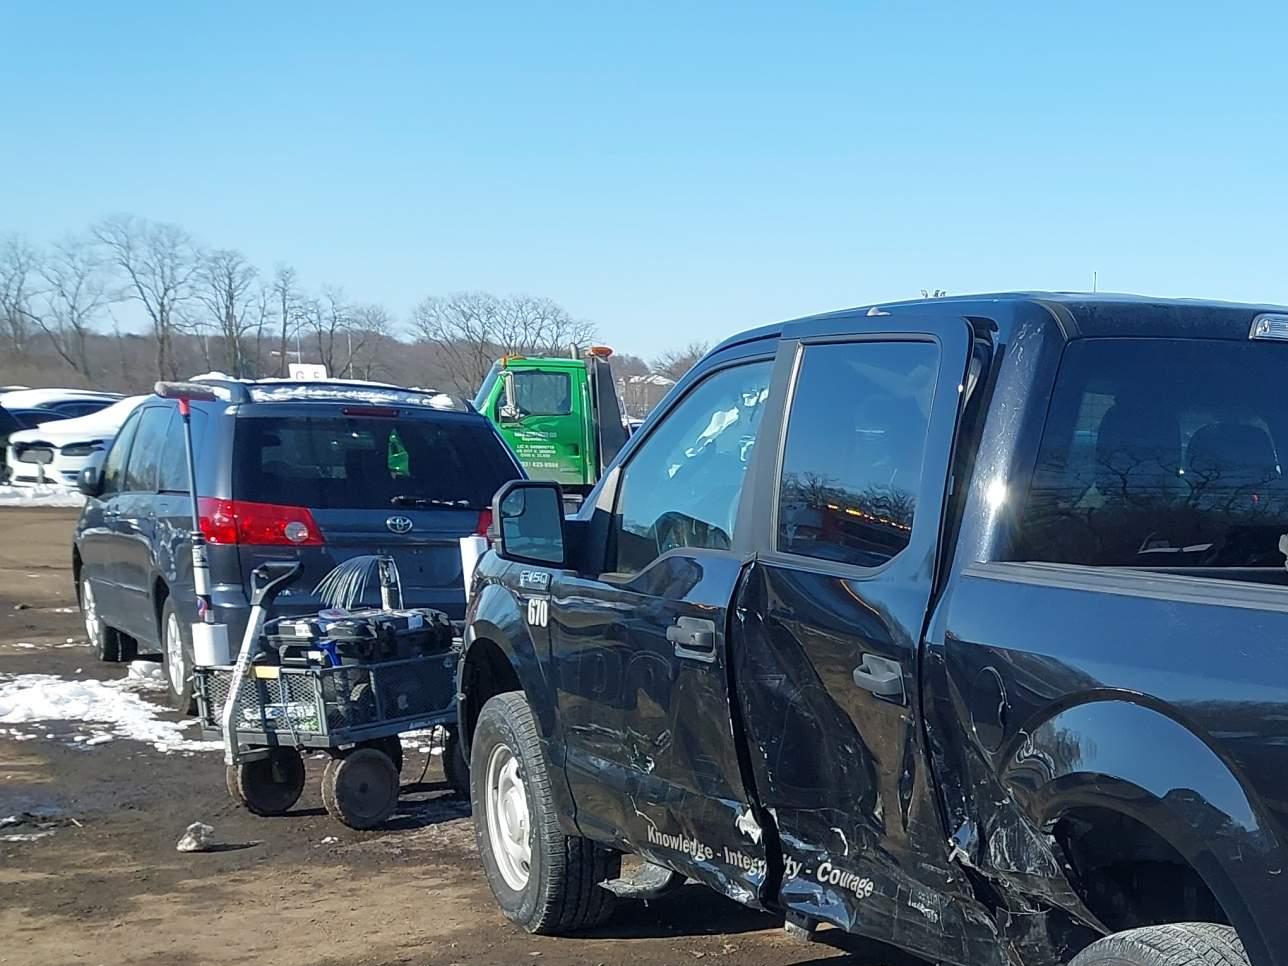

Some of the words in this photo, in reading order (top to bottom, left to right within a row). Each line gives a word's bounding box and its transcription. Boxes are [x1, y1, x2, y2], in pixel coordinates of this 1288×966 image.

[528, 599, 548, 628] 670
[647, 825, 714, 861] Knowledge
[817, 862, 874, 899] Courage
